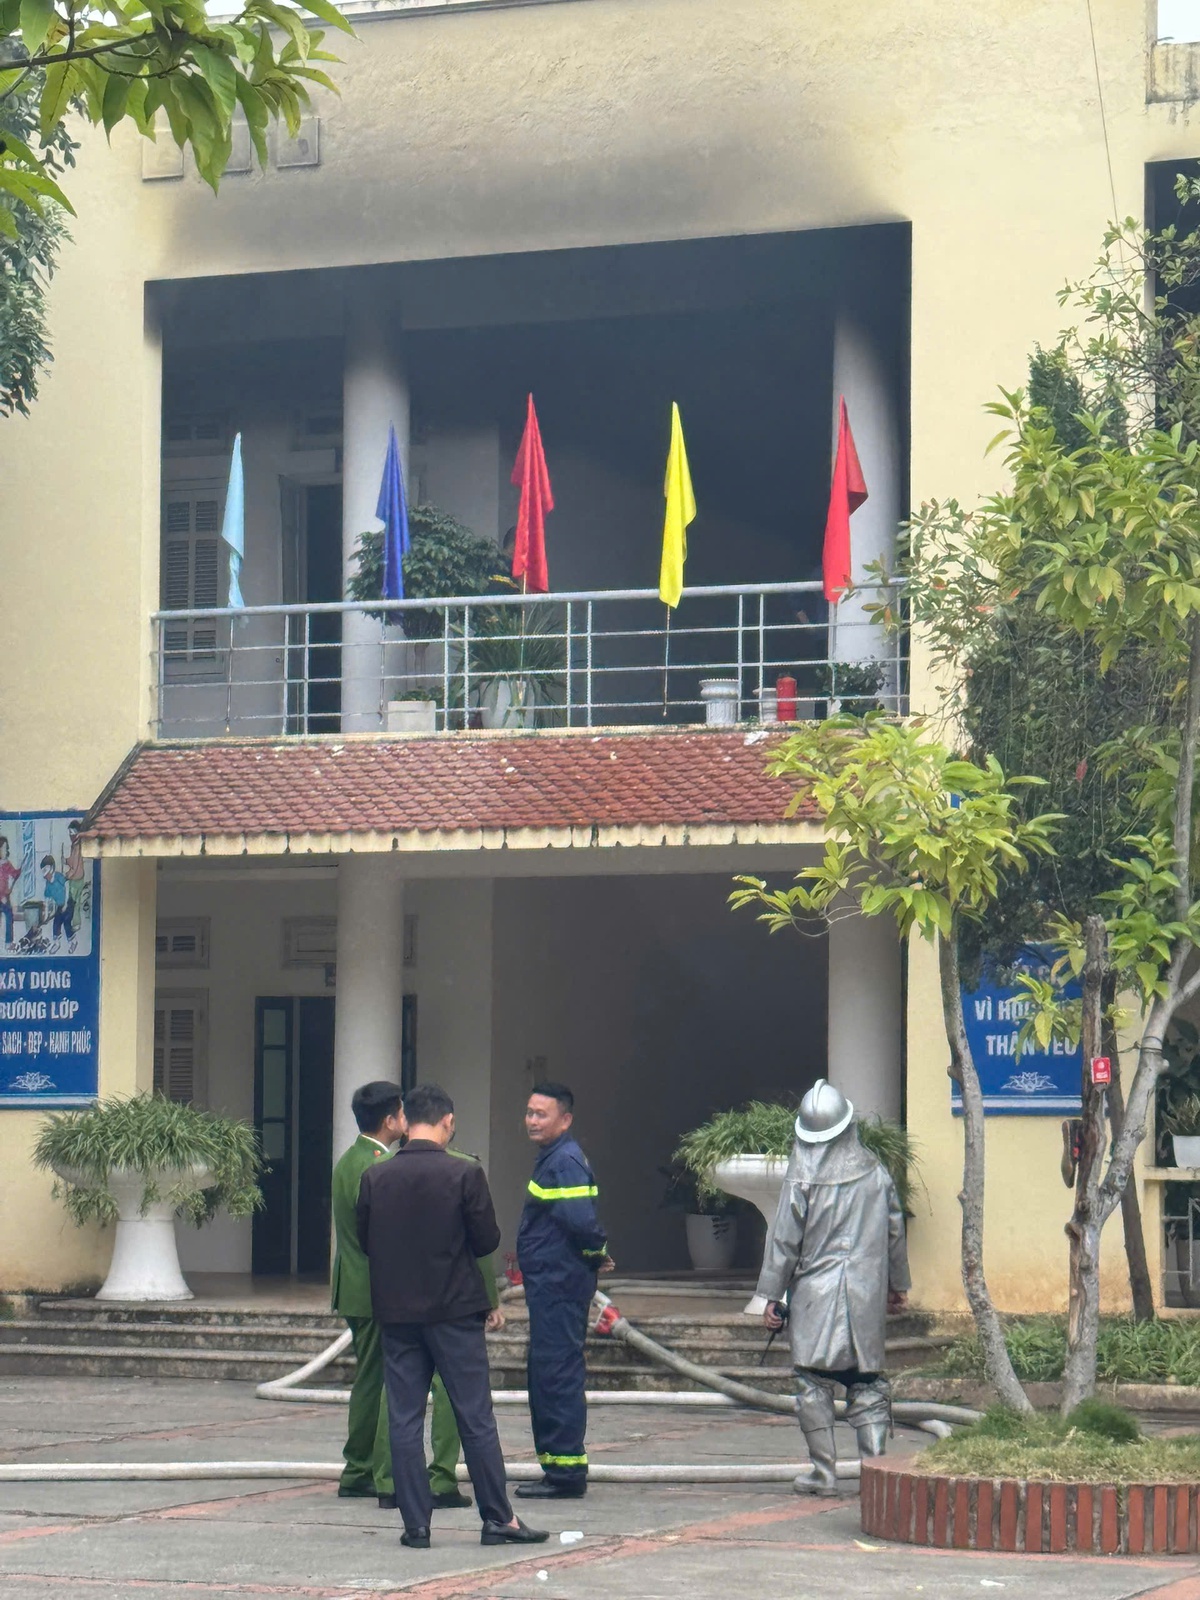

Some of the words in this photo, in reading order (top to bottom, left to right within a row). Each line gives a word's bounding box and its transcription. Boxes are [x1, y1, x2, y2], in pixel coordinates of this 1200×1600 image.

[0, 968, 26, 990] XÂY
[30, 969, 71, 993] DỰNG
[51, 997, 79, 1019] LỚP
[975, 995, 992, 1021] VÌ
[71, 1025, 92, 1054] PHÚC
